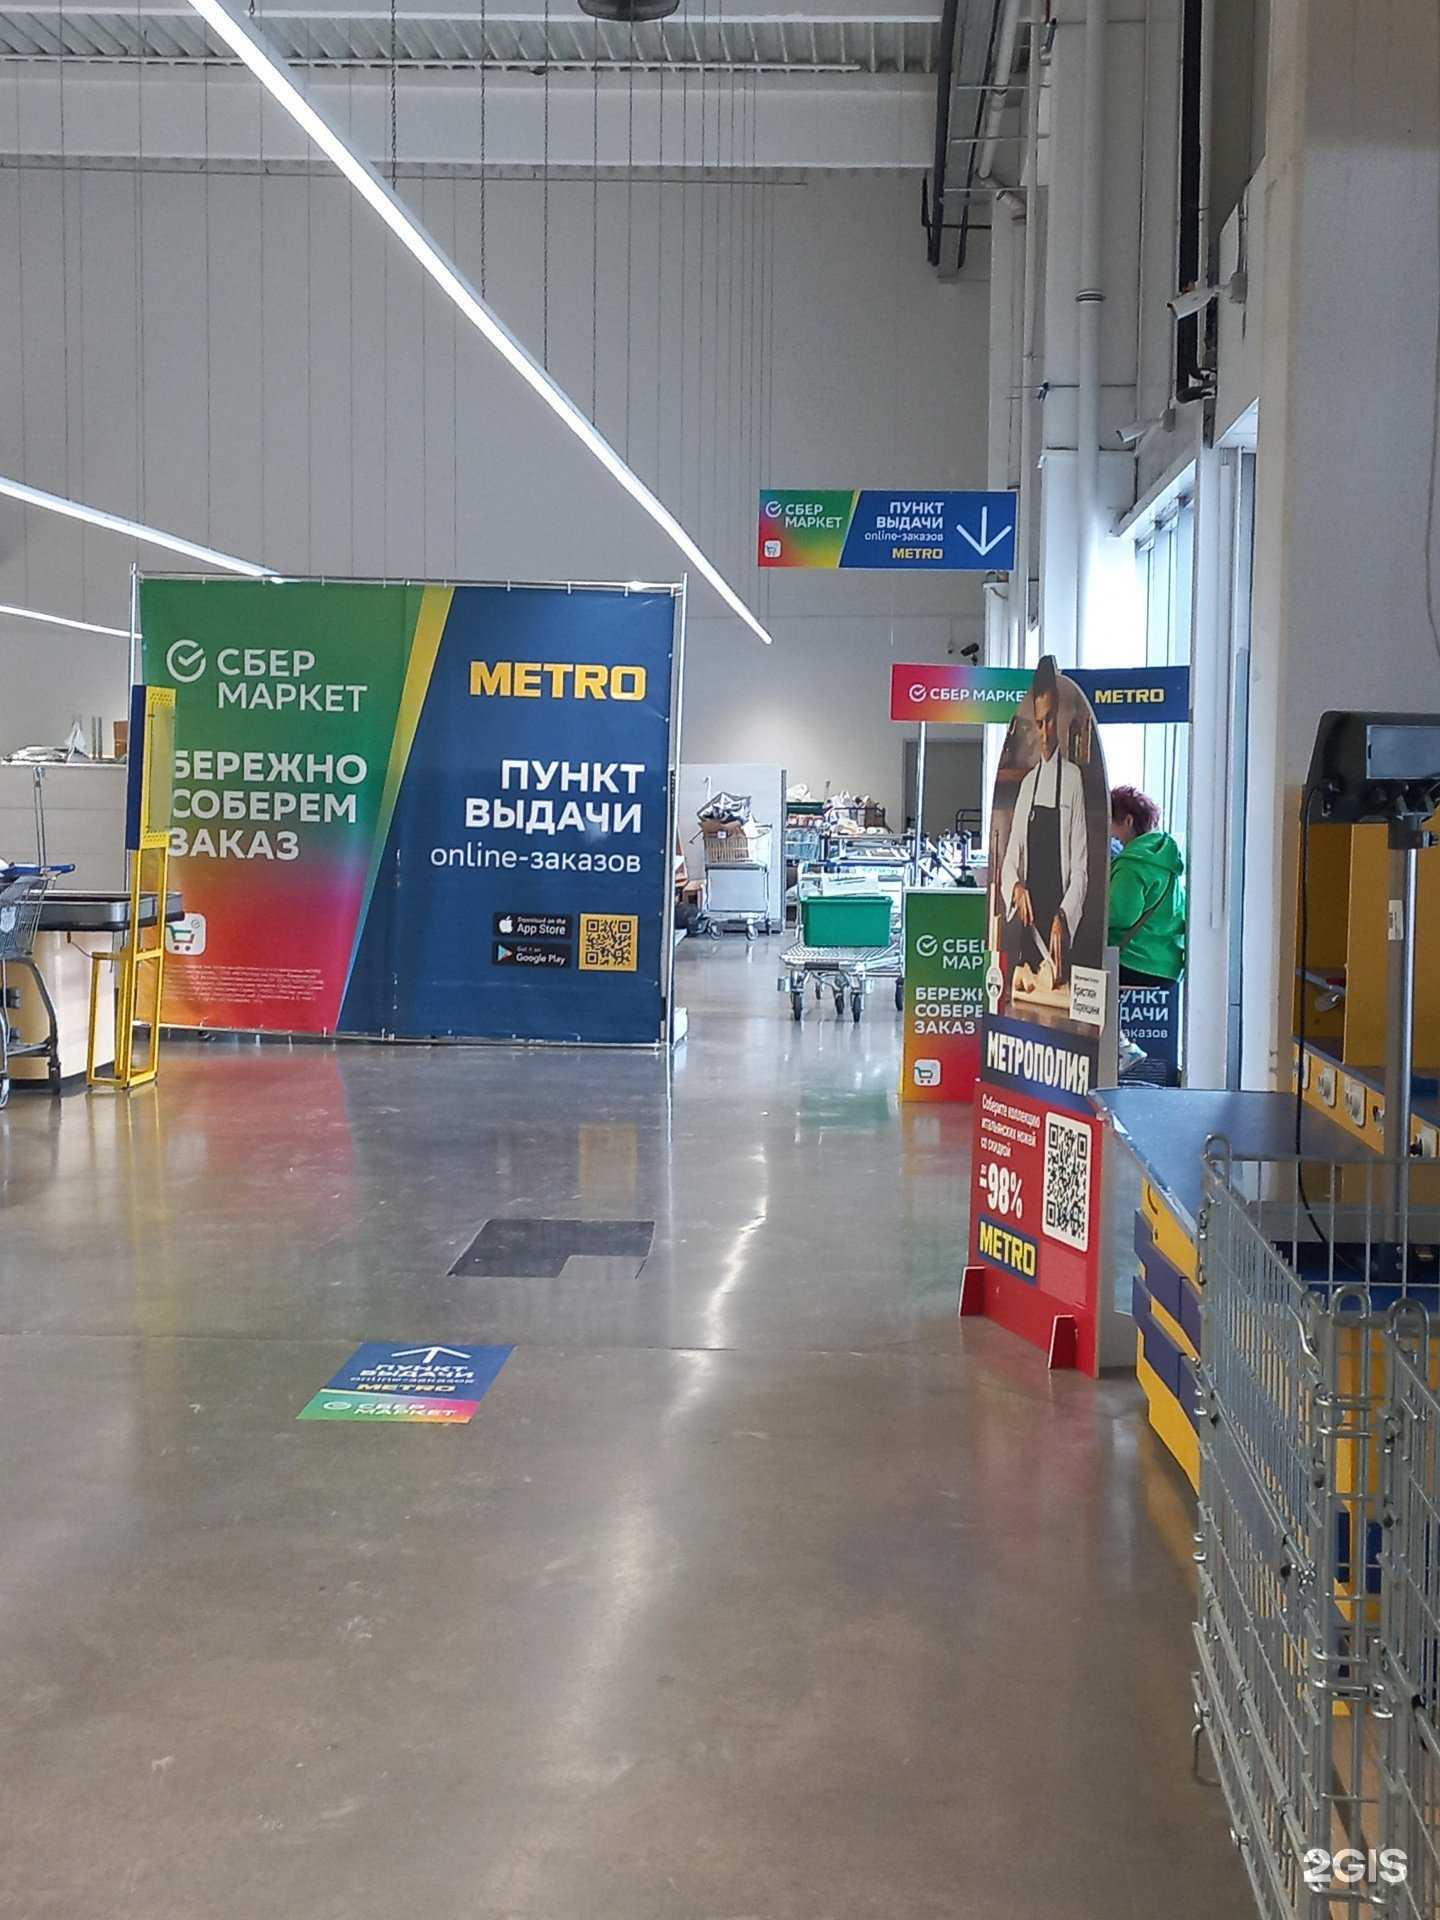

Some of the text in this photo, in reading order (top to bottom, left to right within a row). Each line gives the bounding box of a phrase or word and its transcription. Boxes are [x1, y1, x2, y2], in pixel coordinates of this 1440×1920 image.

[785, 503, 824, 516] СБЕР
[889, 501, 945, 515] ПУНКТ
[785, 516, 843, 529] МАРКЕТ
[876, 516, 944, 530] ВЫДАЧИ
[864, 530, 944, 542] online-заказов
[891, 547, 944, 560] METRO
[217, 648, 316, 678] СБЕР
[469, 660, 647, 701] METRO
[217, 682, 369, 713] МАРКЕТ
[930, 687, 1027, 703] СБЕР МАРКЕ
[1095, 688, 1165, 704] METRO
[175, 750, 368, 785] БЕРЕЖНО
[501, 759, 646, 794] ПУНКТ
[172, 788, 358, 824] СОБЕРЕМ
[465, 797, 642, 836] ВЫДАЧИ
[168, 827, 300, 861] ЗАКАЗ
[430, 841, 642, 873] online-заказов
[516, 923, 566, 935] App Store
[516, 952, 566, 966] Google Play
[942, 955, 983, 970] МАР
[915, 986, 983, 1002] БЕРЕЖ
[1120, 989, 1170, 1005] УНКТ
[914, 1003, 983, 1018] СОБЕРЕ
[1120, 1006, 1169, 1022] ДАЧИ
[914, 1020, 976, 1035] ЗАКАЗ
[986, 1030, 1090, 1096] МЕТРОПОЛИЯ
[979, 1220, 1036, 1277] METRO
[359, 1370, 475, 1378] ВЫДАЧИ
[376, 1364, 469, 1372] ПУНКТ
[356, 1384, 457, 1392] METRO
[353, 1409, 458, 1417] МАРКЕТ
